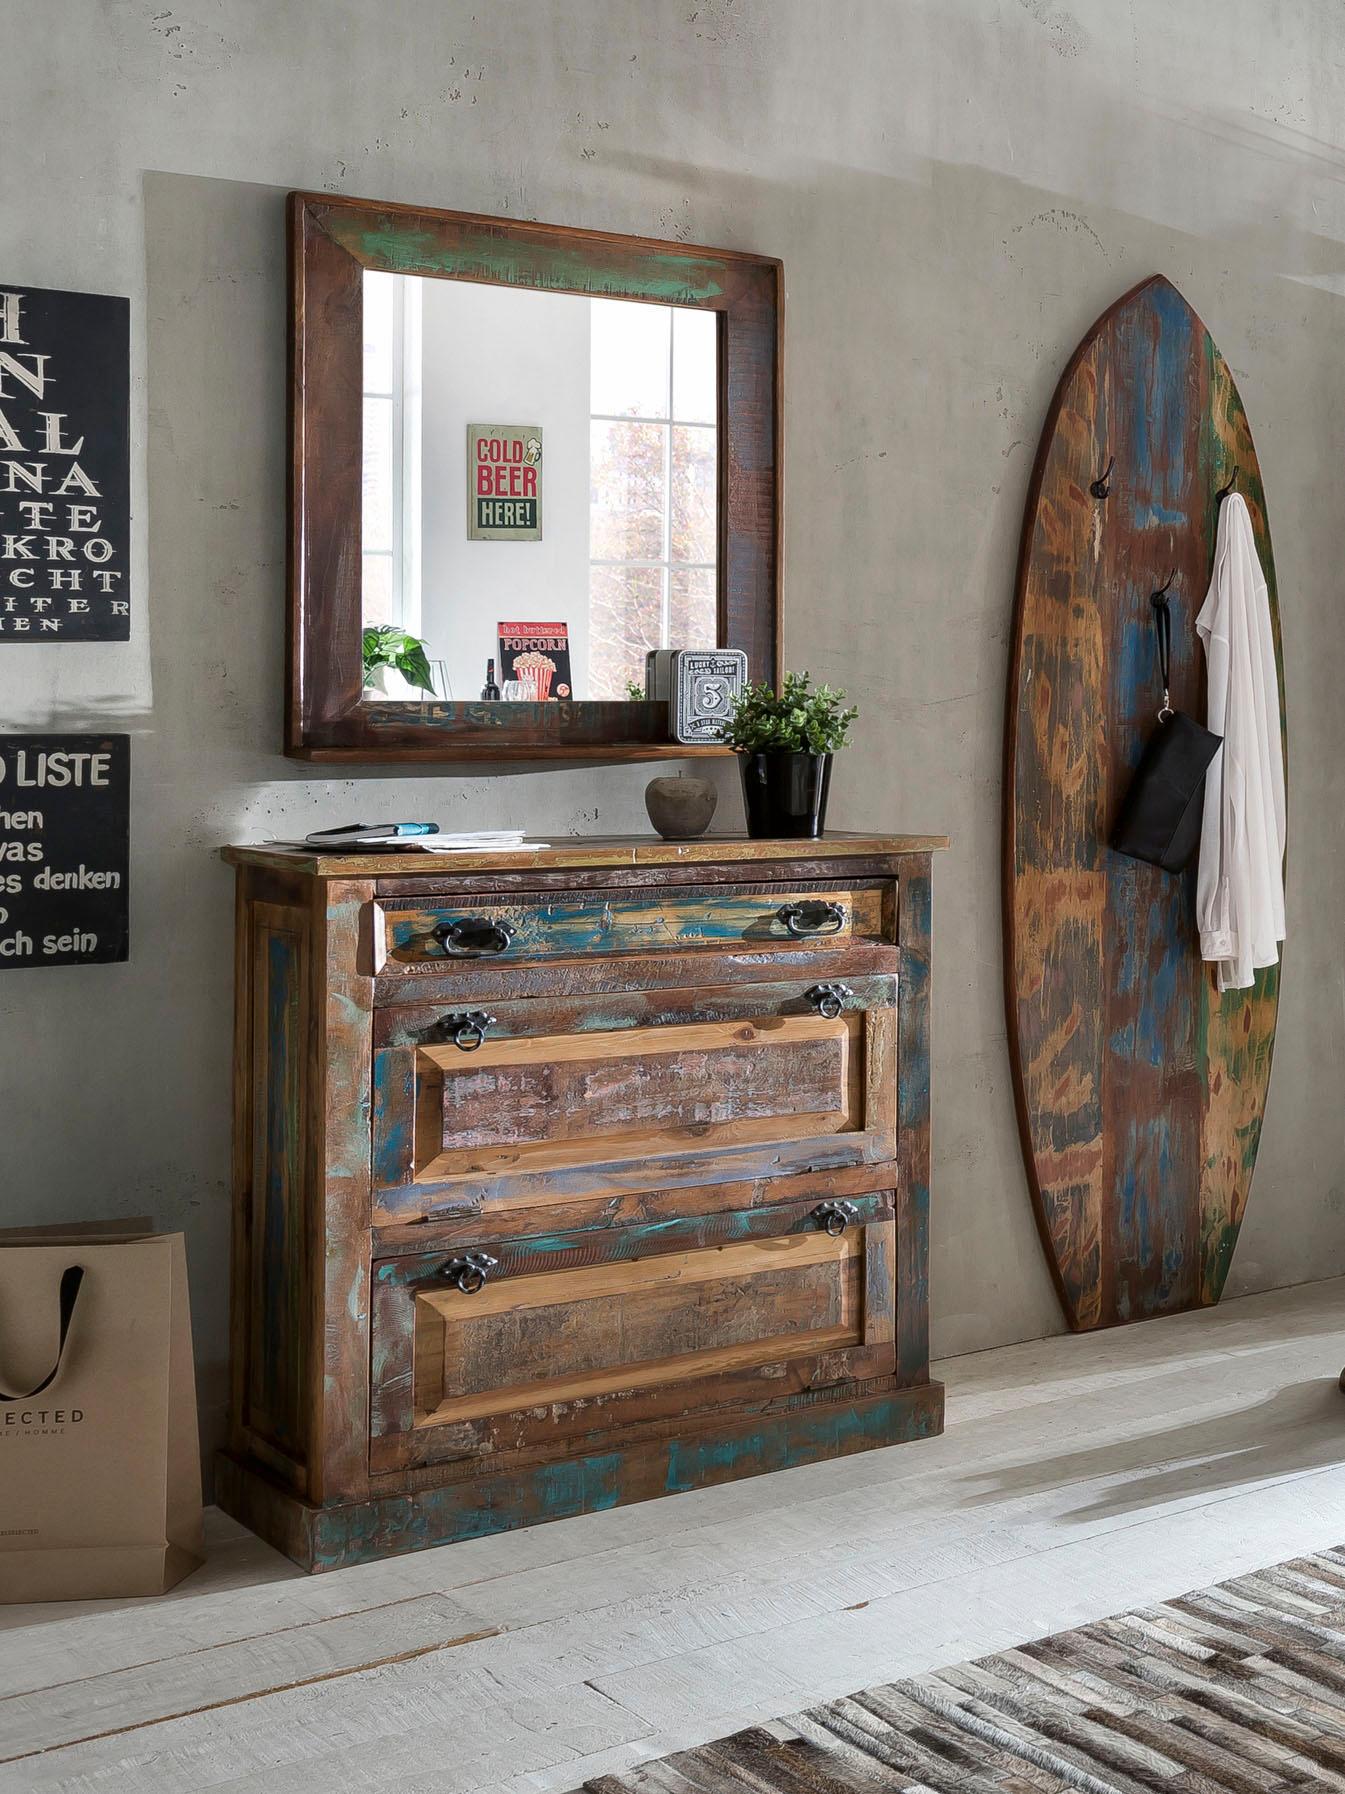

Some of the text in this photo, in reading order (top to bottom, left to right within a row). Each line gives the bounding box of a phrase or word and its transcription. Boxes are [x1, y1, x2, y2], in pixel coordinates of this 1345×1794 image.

[477, 438, 524, 464] COLD
[0, 461, 103, 497] NA
[477, 464, 537, 497] BEER
[19, 501, 102, 533] TE
[481, 501, 531, 526] HERE!
[1, 534, 117, 563] KRO
[9, 568, 121, 592] CHT
[503, 638, 567, 651] POPCORN
[702, 683, 723, 709] 5
[17, 750, 112, 787] LISTE
[33, 864, 121, 890] denken
[0, 928, 98, 956] ch sein
[5, 1409, 84, 1425] ECTED
